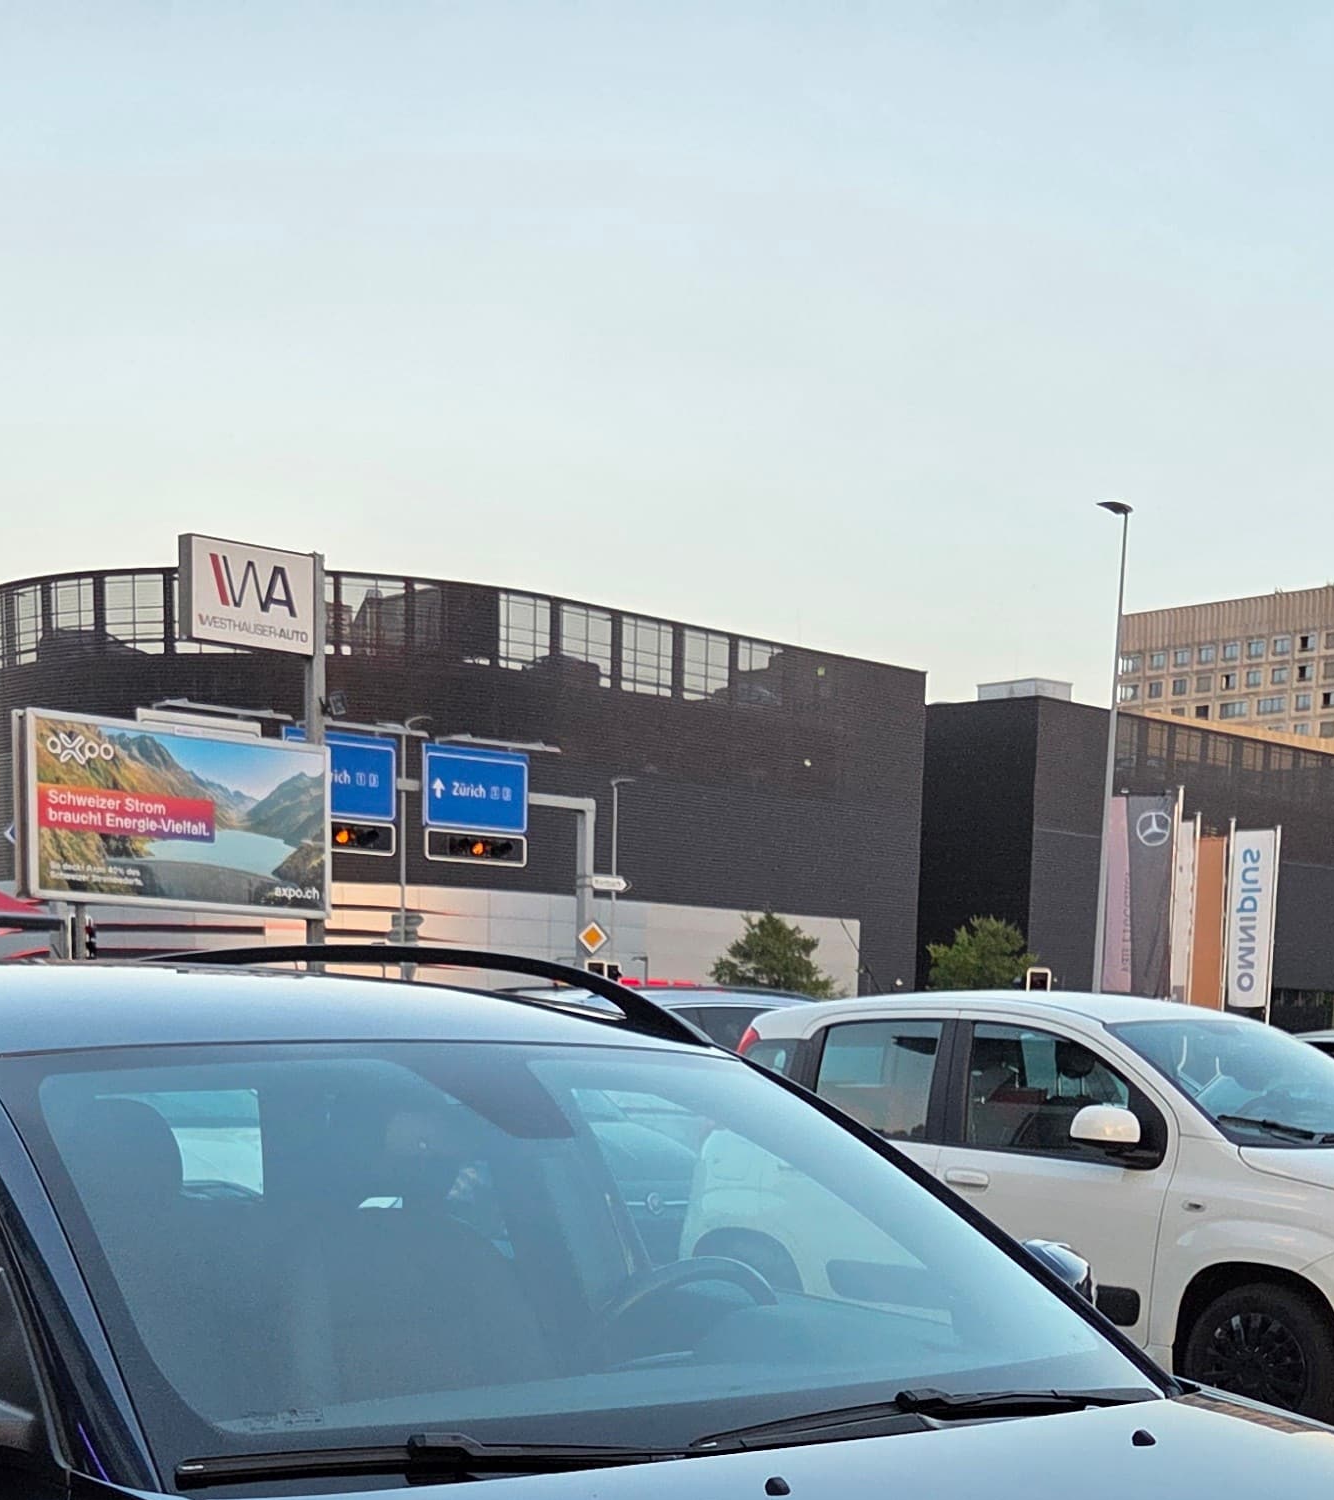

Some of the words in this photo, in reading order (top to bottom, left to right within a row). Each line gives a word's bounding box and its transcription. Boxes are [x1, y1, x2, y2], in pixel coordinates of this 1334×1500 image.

[46, 732, 115, 765] axpo
[47, 789, 121, 811] Schweizer
[124, 798, 166, 815] Strom
[452, 781, 486, 799] Zürich
[47, 807, 102, 826] braucht
[105, 814, 210, 837] Energie-Vielfalt.
[274, 886, 320, 900] axpo.ch
